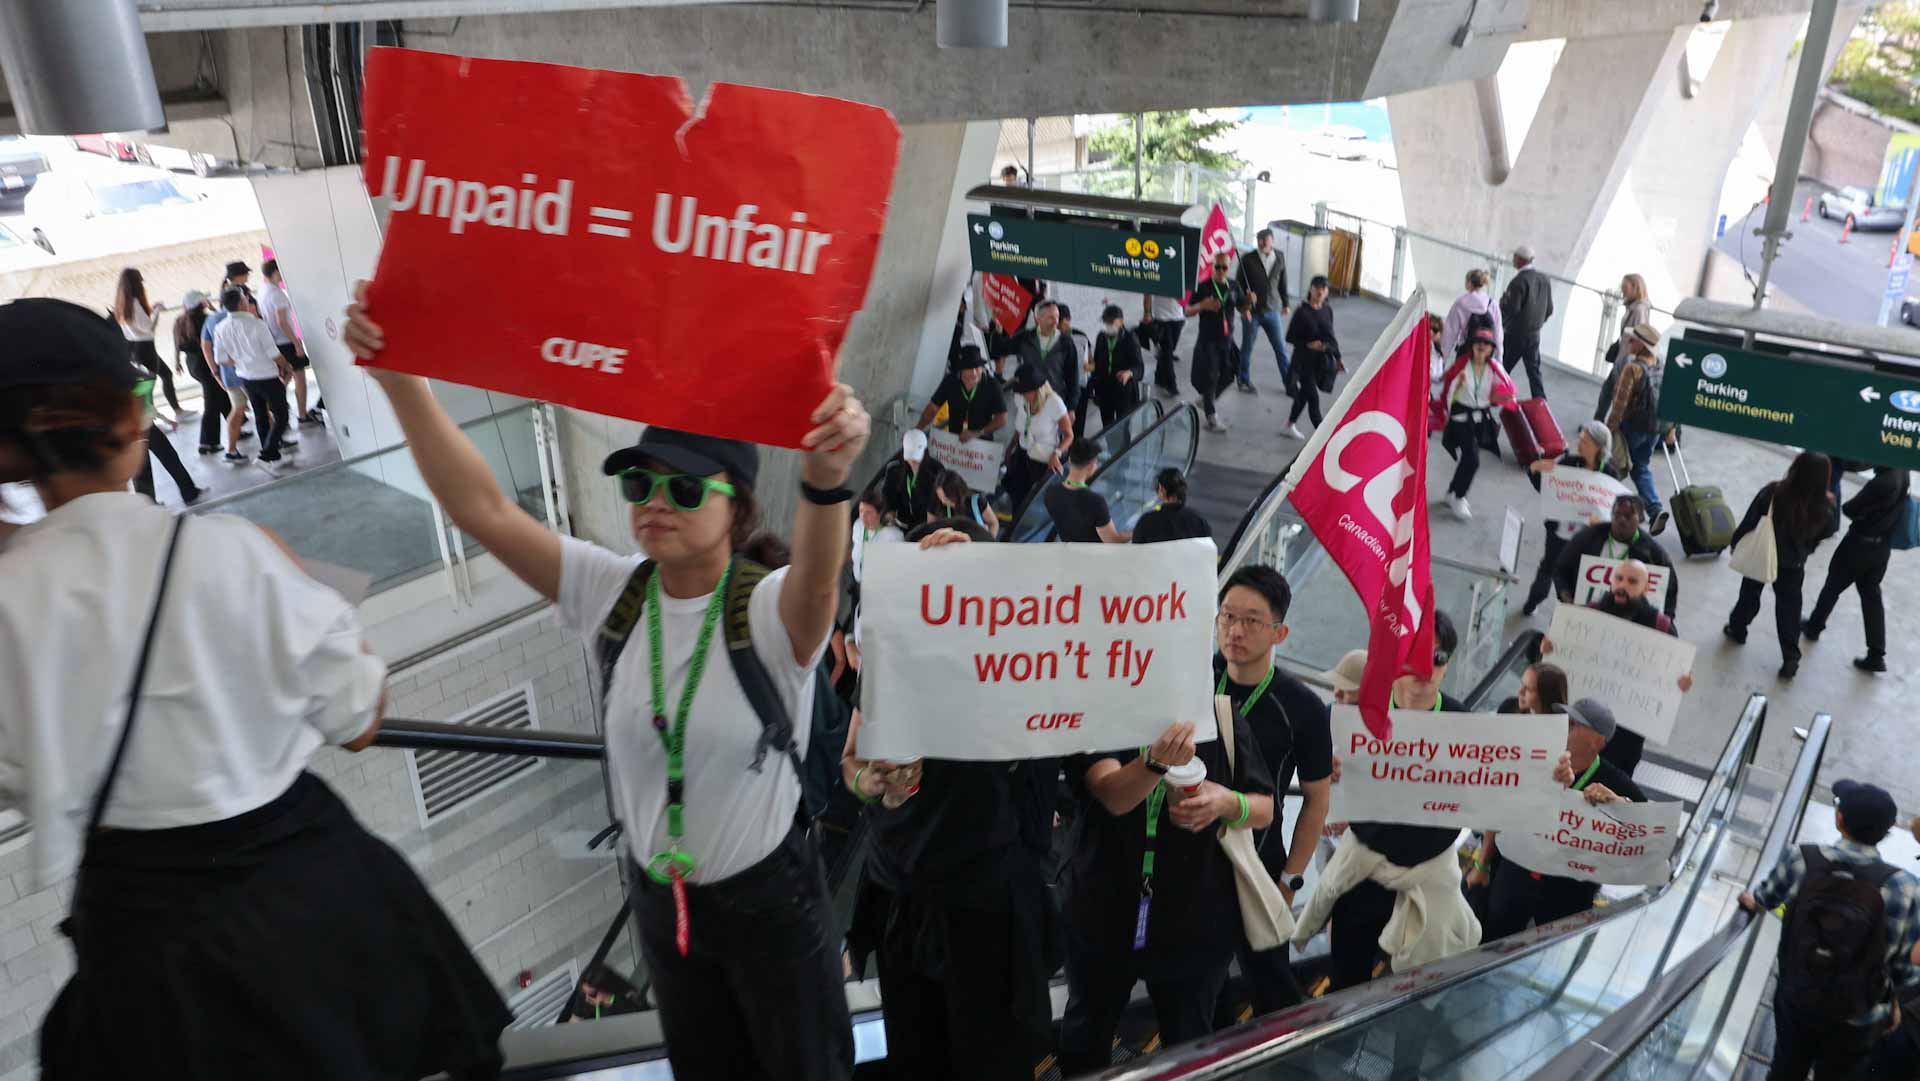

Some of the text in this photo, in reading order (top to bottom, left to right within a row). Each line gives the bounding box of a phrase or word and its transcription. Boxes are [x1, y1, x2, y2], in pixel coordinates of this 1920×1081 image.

[381, 156, 831, 275] Unpaid = Unfair
[990, 240, 1019, 254] Parking
[991, 250, 1048, 266] Stationnement
[1090, 262, 1160, 281] Train vers la ville
[1107, 254, 1160, 272] Train to City
[541, 336, 629, 374] CUPE
[1697, 378, 1748, 402] Parking
[1694, 393, 1794, 424] Stationnement
[1882, 413, 1920, 434] Inter
[1881, 430, 1912, 448] Vols
[1338, 514, 1387, 562] Canadian
[920, 582, 1188, 636] Unpaid work
[1565, 618, 1592, 639] MY
[975, 640, 1154, 687] won't fly
[1026, 712, 1085, 730] CUPE
[1350, 733, 1440, 760] Poverty
[1448, 740, 1521, 764] wages
[1371, 763, 1519, 786] UnCanadian
[1423, 801, 1459, 813] CUPE
[1591, 818, 1648, 841] wages
[1534, 829, 1645, 856] Canadian
[1567, 860, 1598, 873] CUPE
